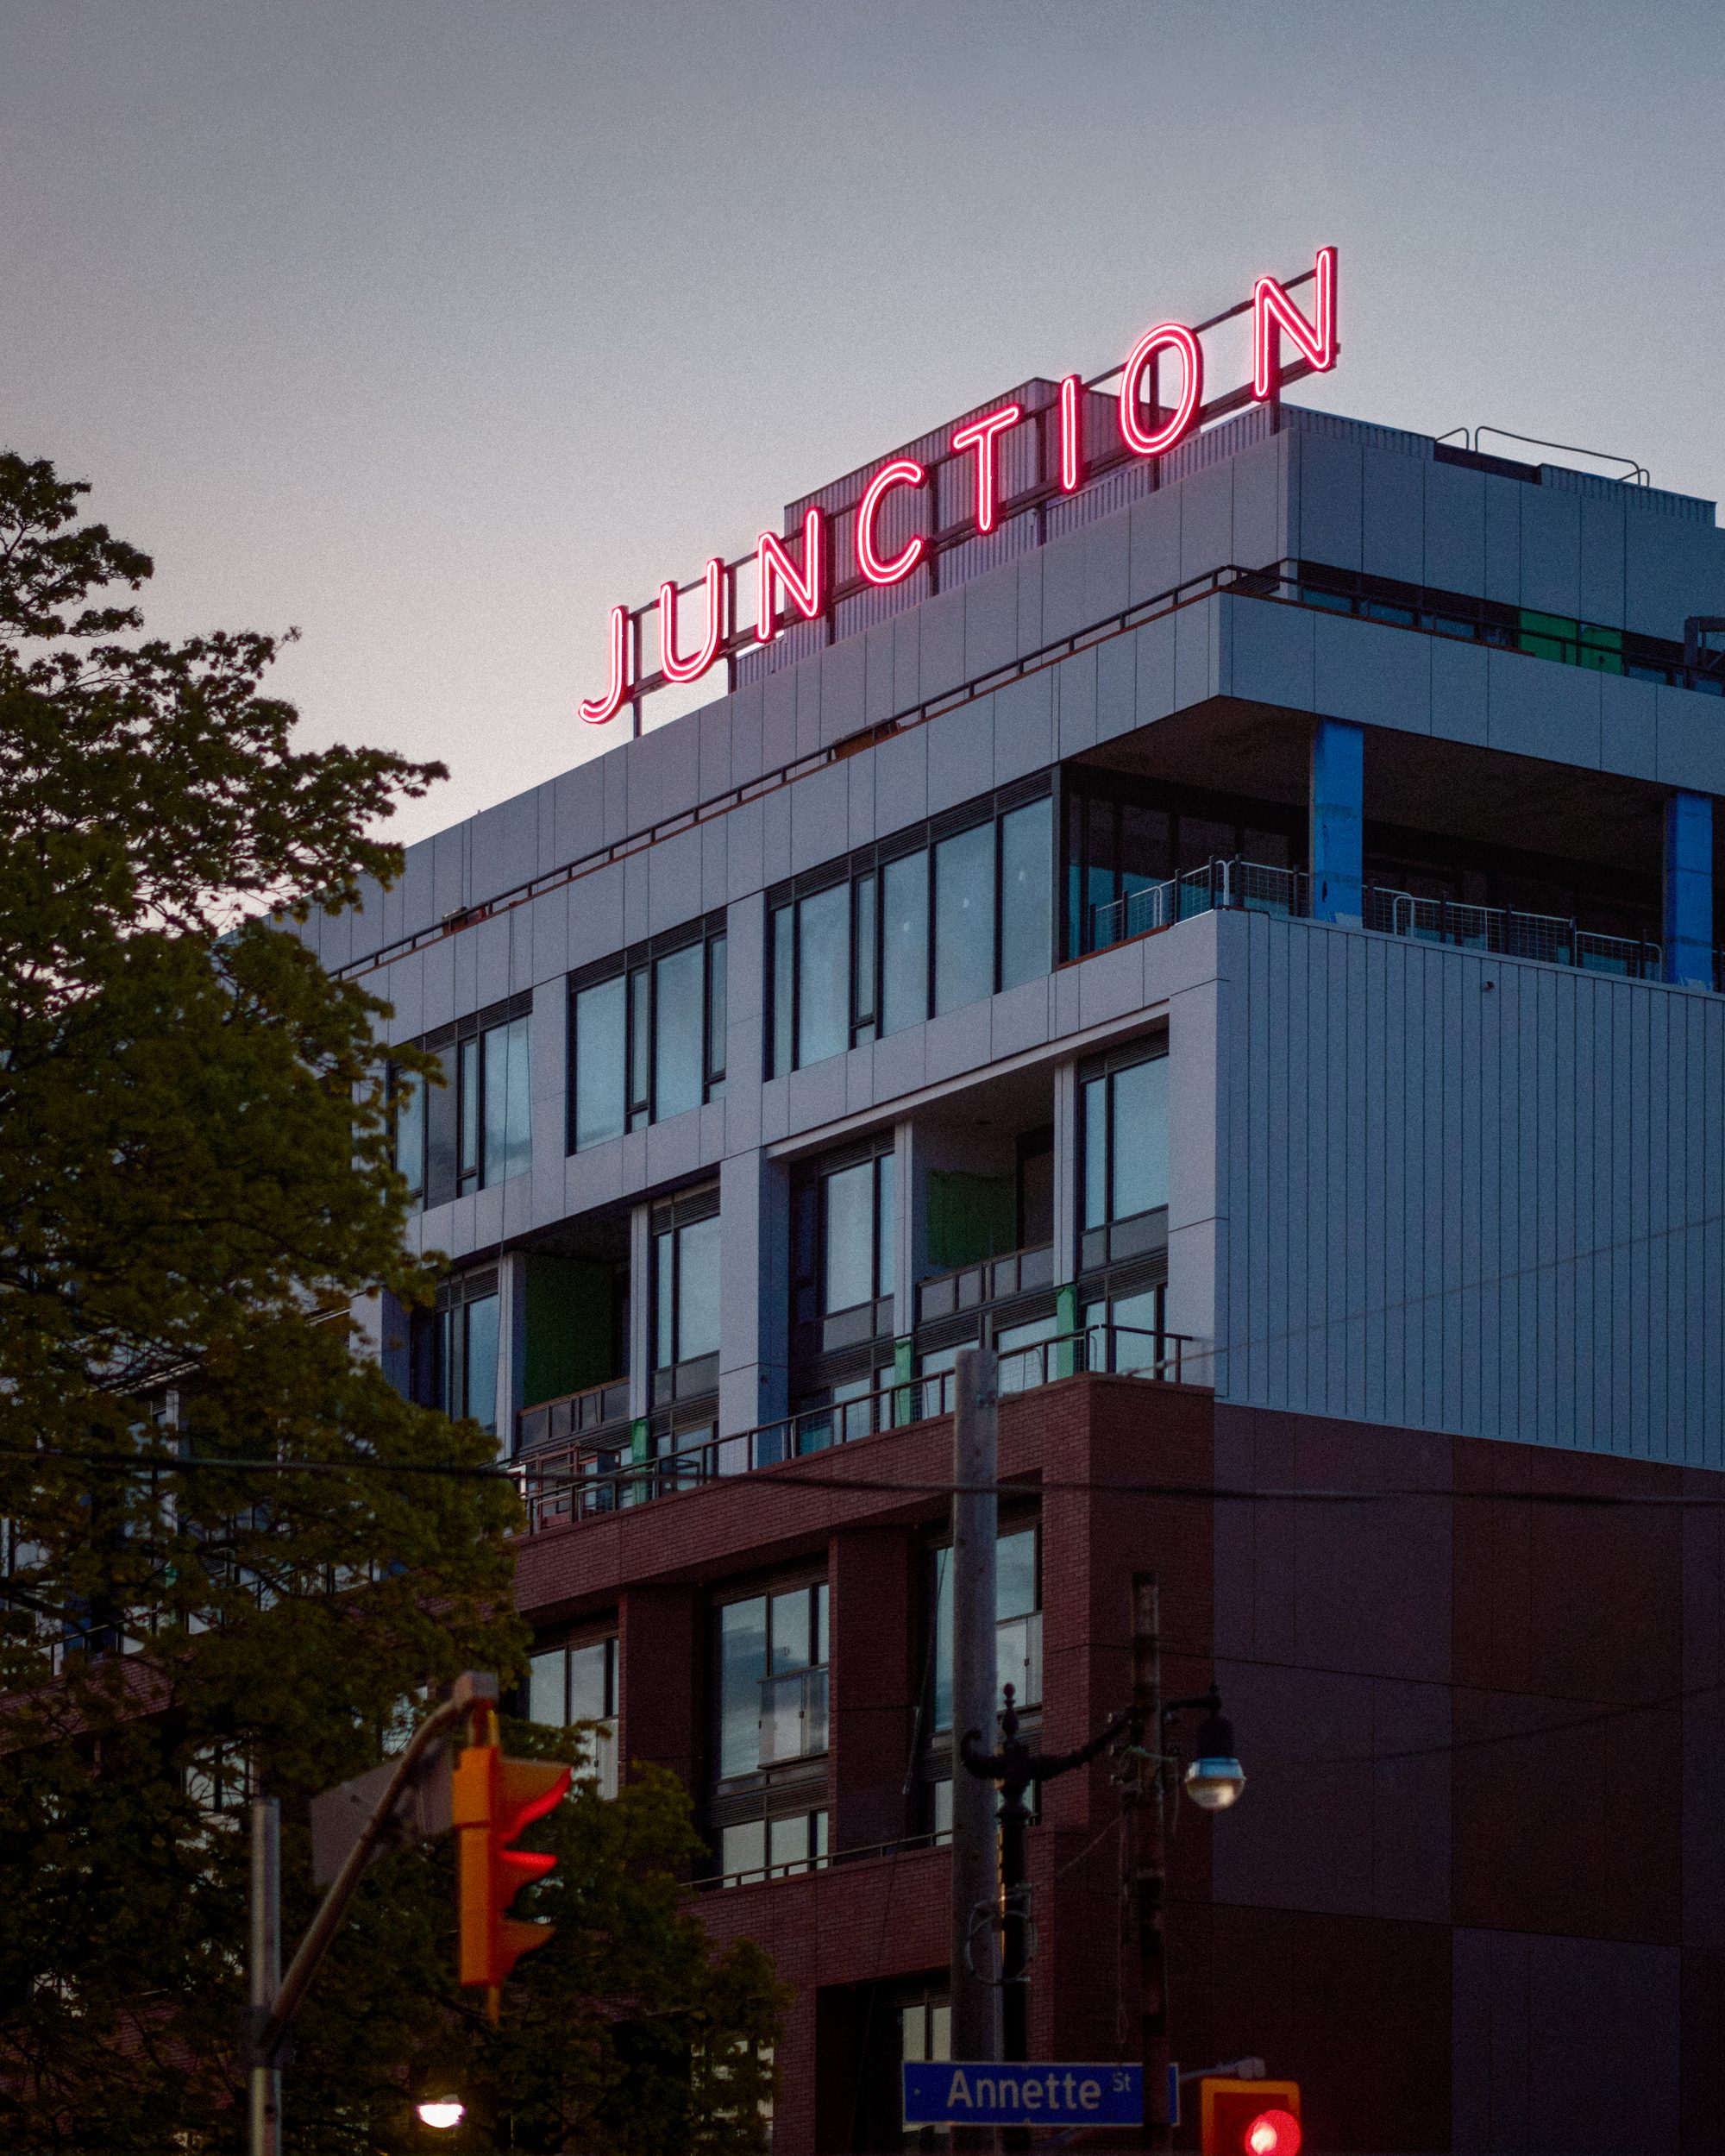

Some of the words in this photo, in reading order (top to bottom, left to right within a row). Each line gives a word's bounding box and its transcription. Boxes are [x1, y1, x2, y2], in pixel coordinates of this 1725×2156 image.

[579, 247, 1338, 725] JUNCTION
[946, 2069, 1101, 2109] Annette
[1112, 2072, 1131, 2092] St
